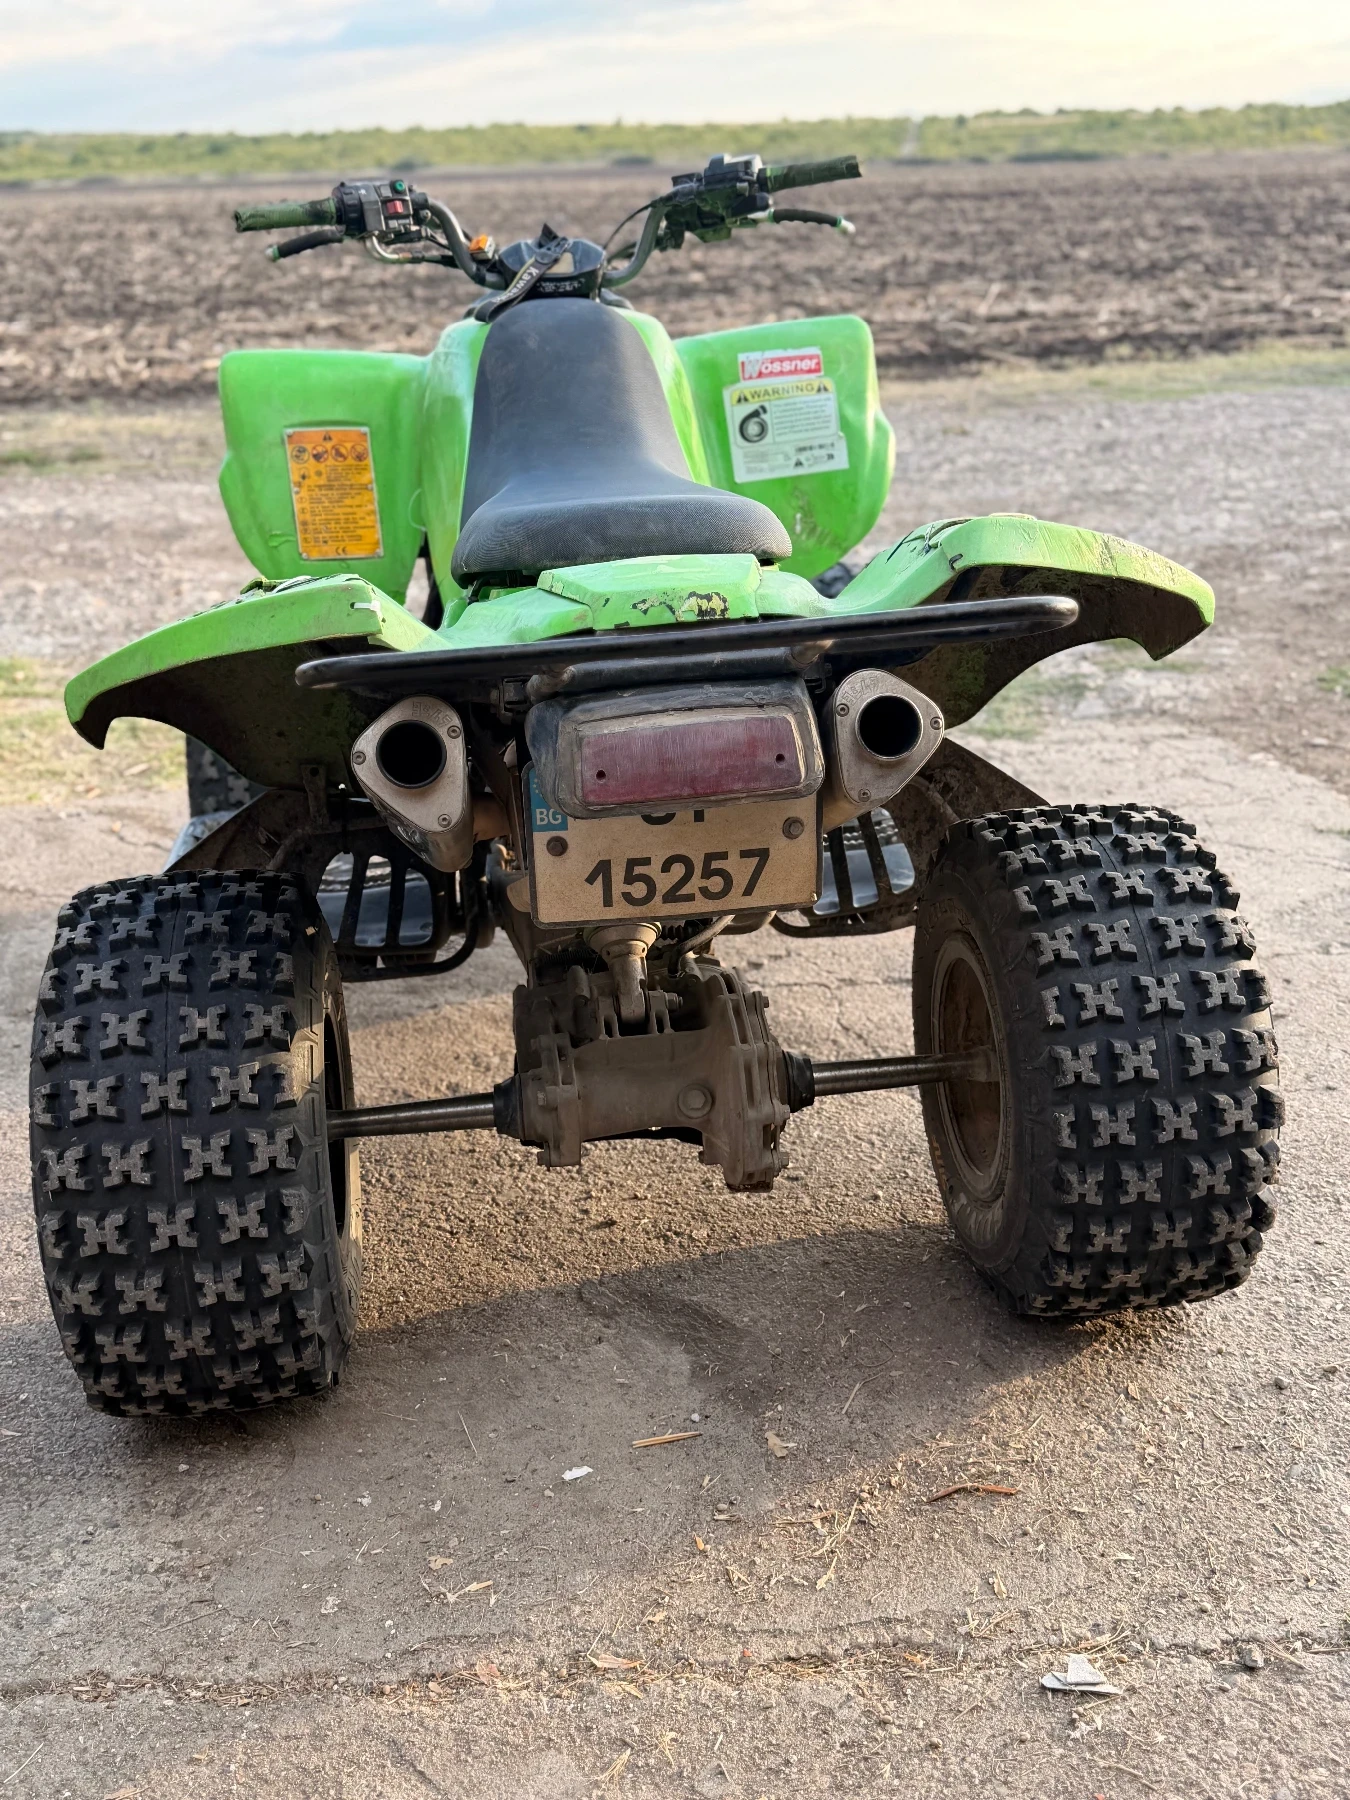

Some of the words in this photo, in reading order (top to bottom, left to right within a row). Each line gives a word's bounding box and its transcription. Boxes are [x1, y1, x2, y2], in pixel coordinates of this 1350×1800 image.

[748, 383, 815, 400] WARNING
[536, 808, 562, 825] BG
[584, 848, 770, 907] 15257
